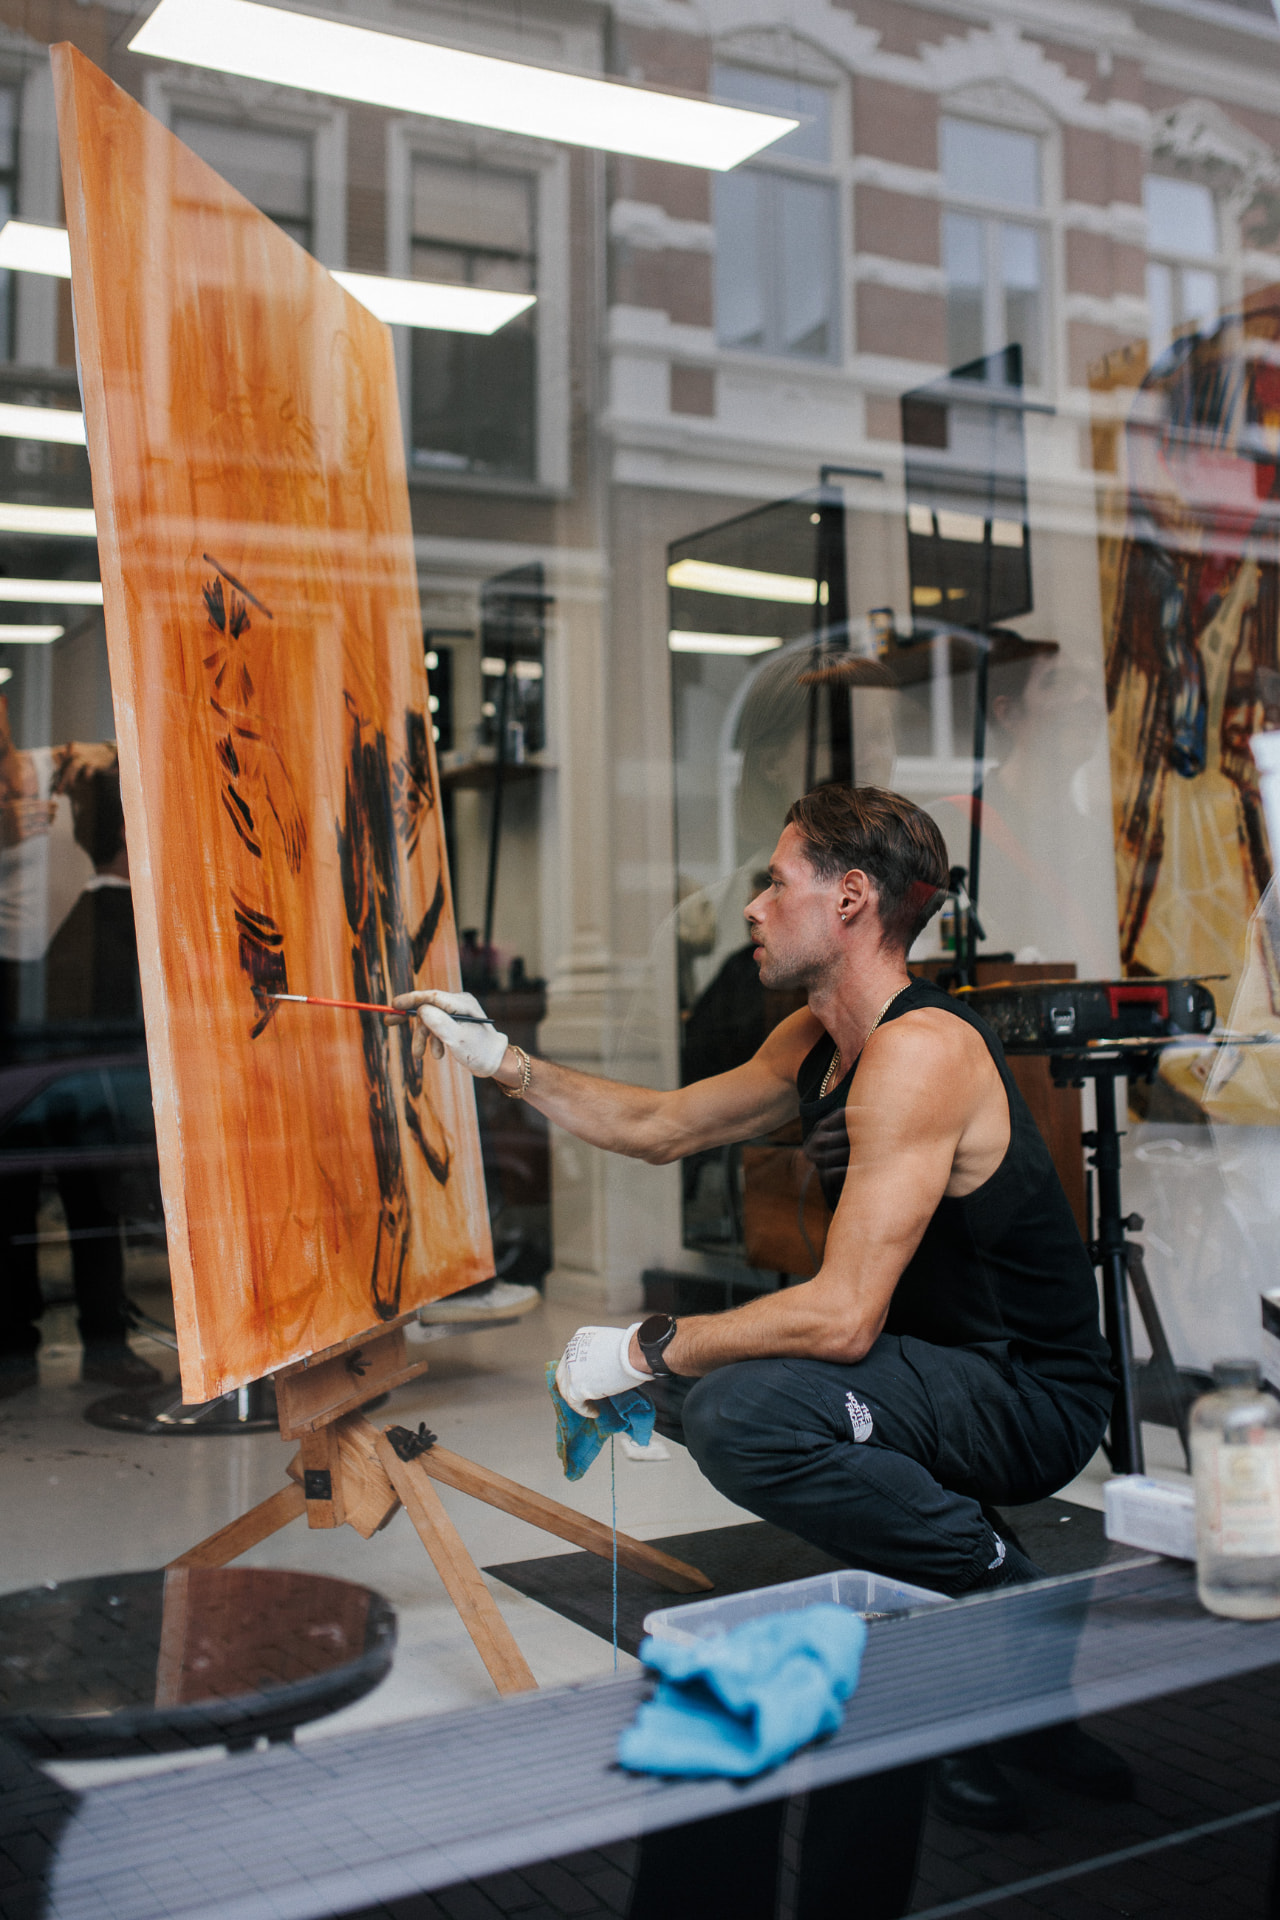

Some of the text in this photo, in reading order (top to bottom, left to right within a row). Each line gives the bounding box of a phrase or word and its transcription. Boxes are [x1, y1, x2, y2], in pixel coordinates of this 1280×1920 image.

[845, 1391, 866, 1426] NORTH
[845, 1402, 860, 1429] FACE
[860, 1402, 873, 1424] THE
